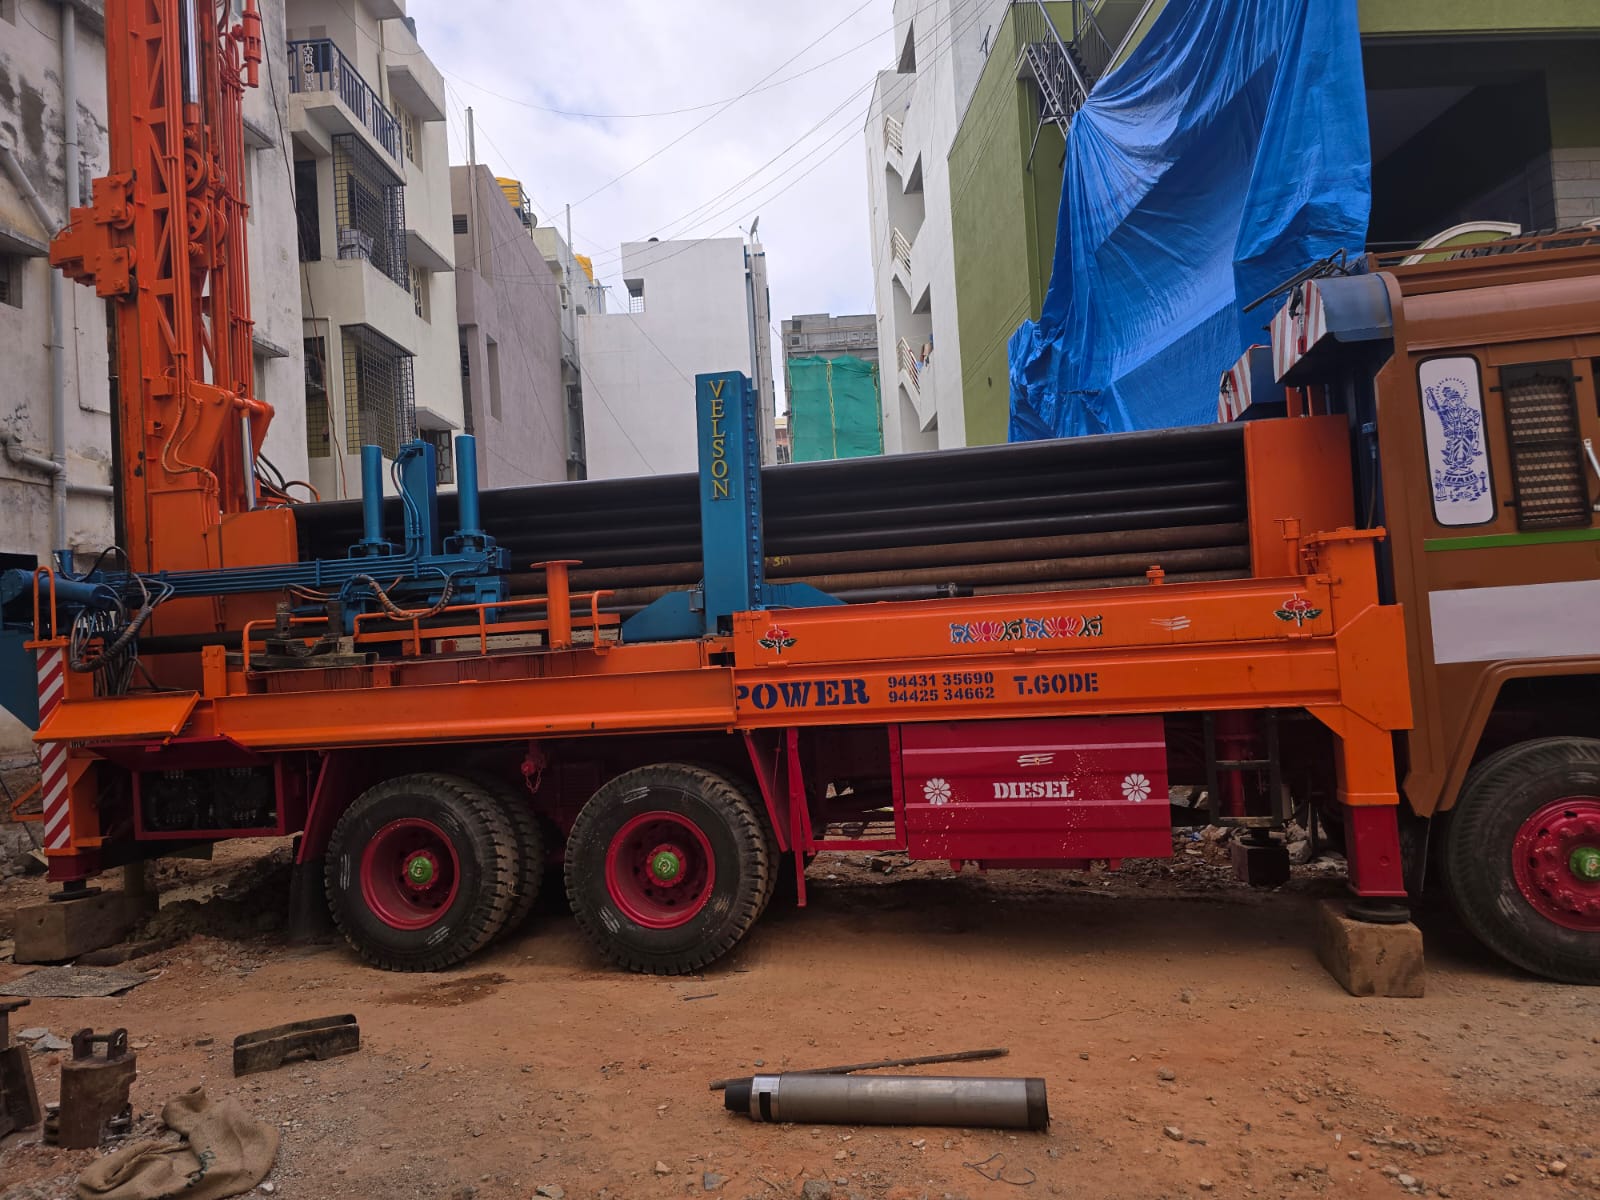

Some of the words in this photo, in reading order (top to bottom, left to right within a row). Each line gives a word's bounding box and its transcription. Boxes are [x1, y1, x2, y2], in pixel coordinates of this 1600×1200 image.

[709, 379, 728, 498] VELSON
[888, 675, 936, 688] 94431
[942, 671, 994, 686] 35690
[1013, 672, 1098, 695] T.GODE
[888, 689, 939, 703] 94425
[943, 686, 995, 701] 34662
[992, 781, 1075, 799] DIESEL
